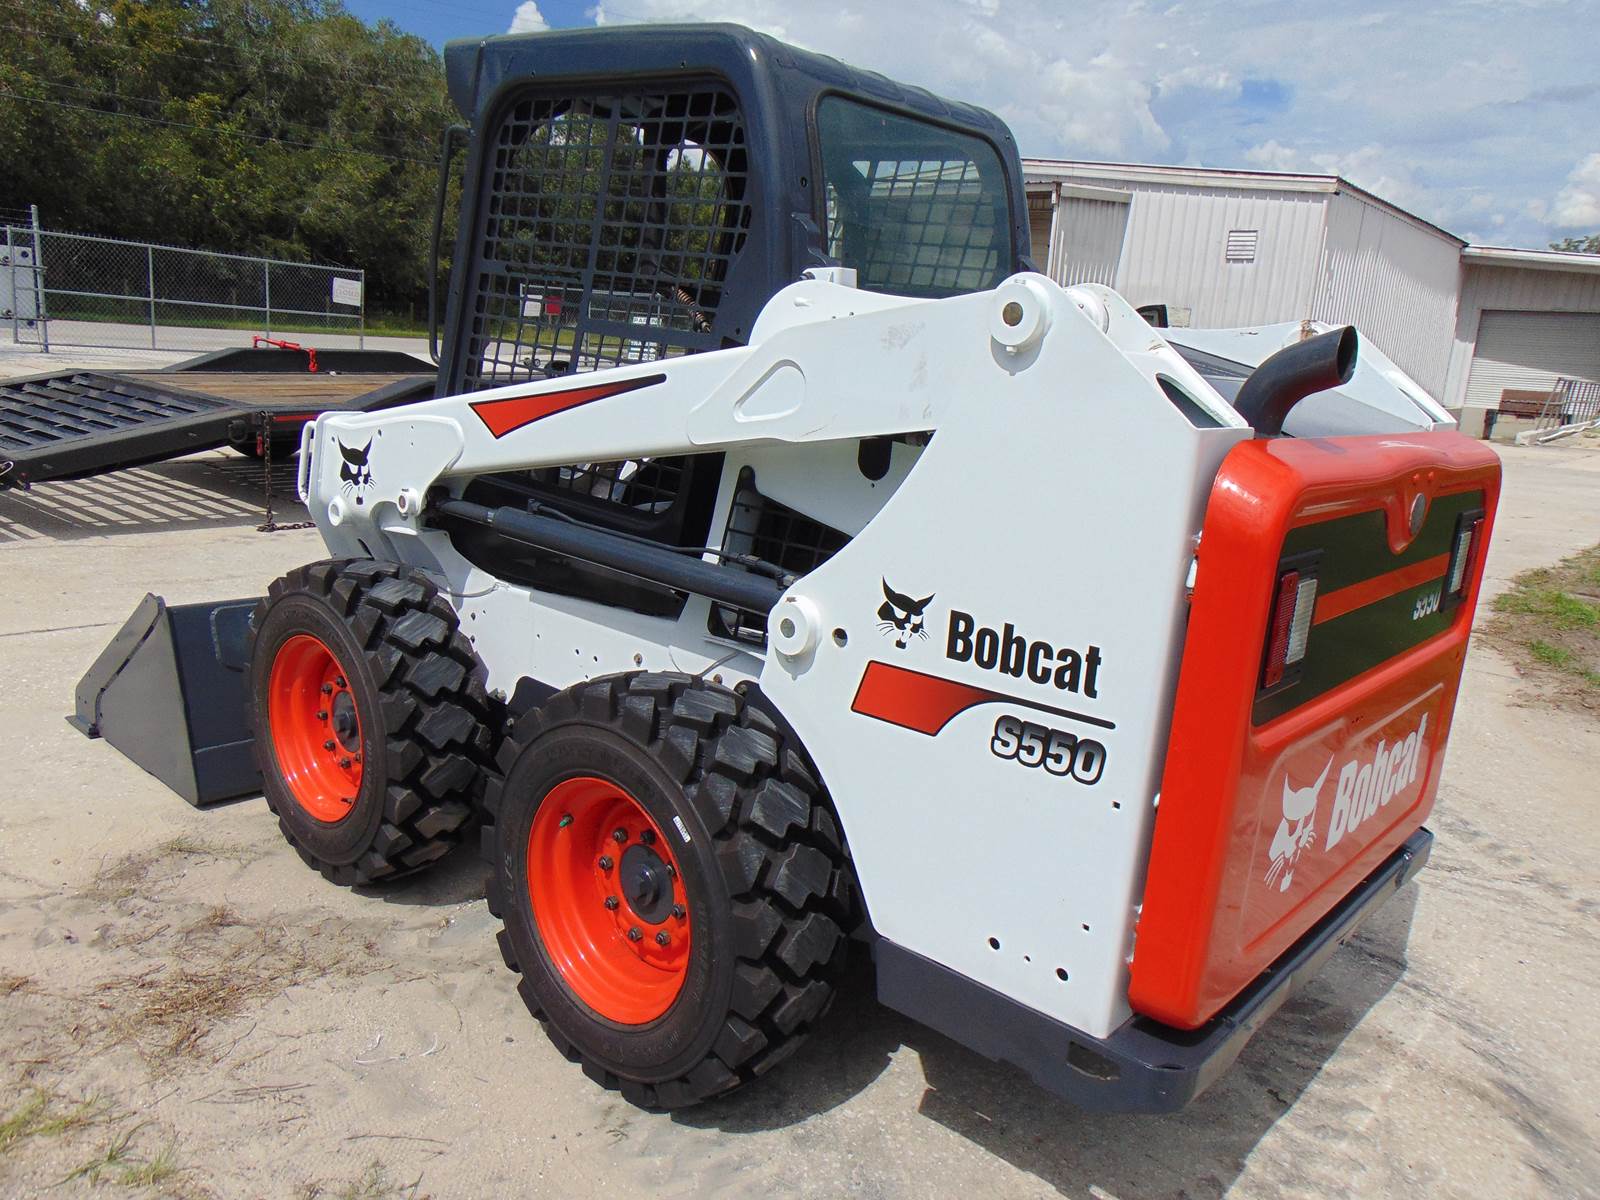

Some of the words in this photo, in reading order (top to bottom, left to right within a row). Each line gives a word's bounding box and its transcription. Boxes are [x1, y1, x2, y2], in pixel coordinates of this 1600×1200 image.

[1412, 592, 1441, 620] S550
[946, 609, 1101, 699] Bobcat
[990, 714, 1107, 786] S550
[1325, 711, 1428, 852] Bobcat
